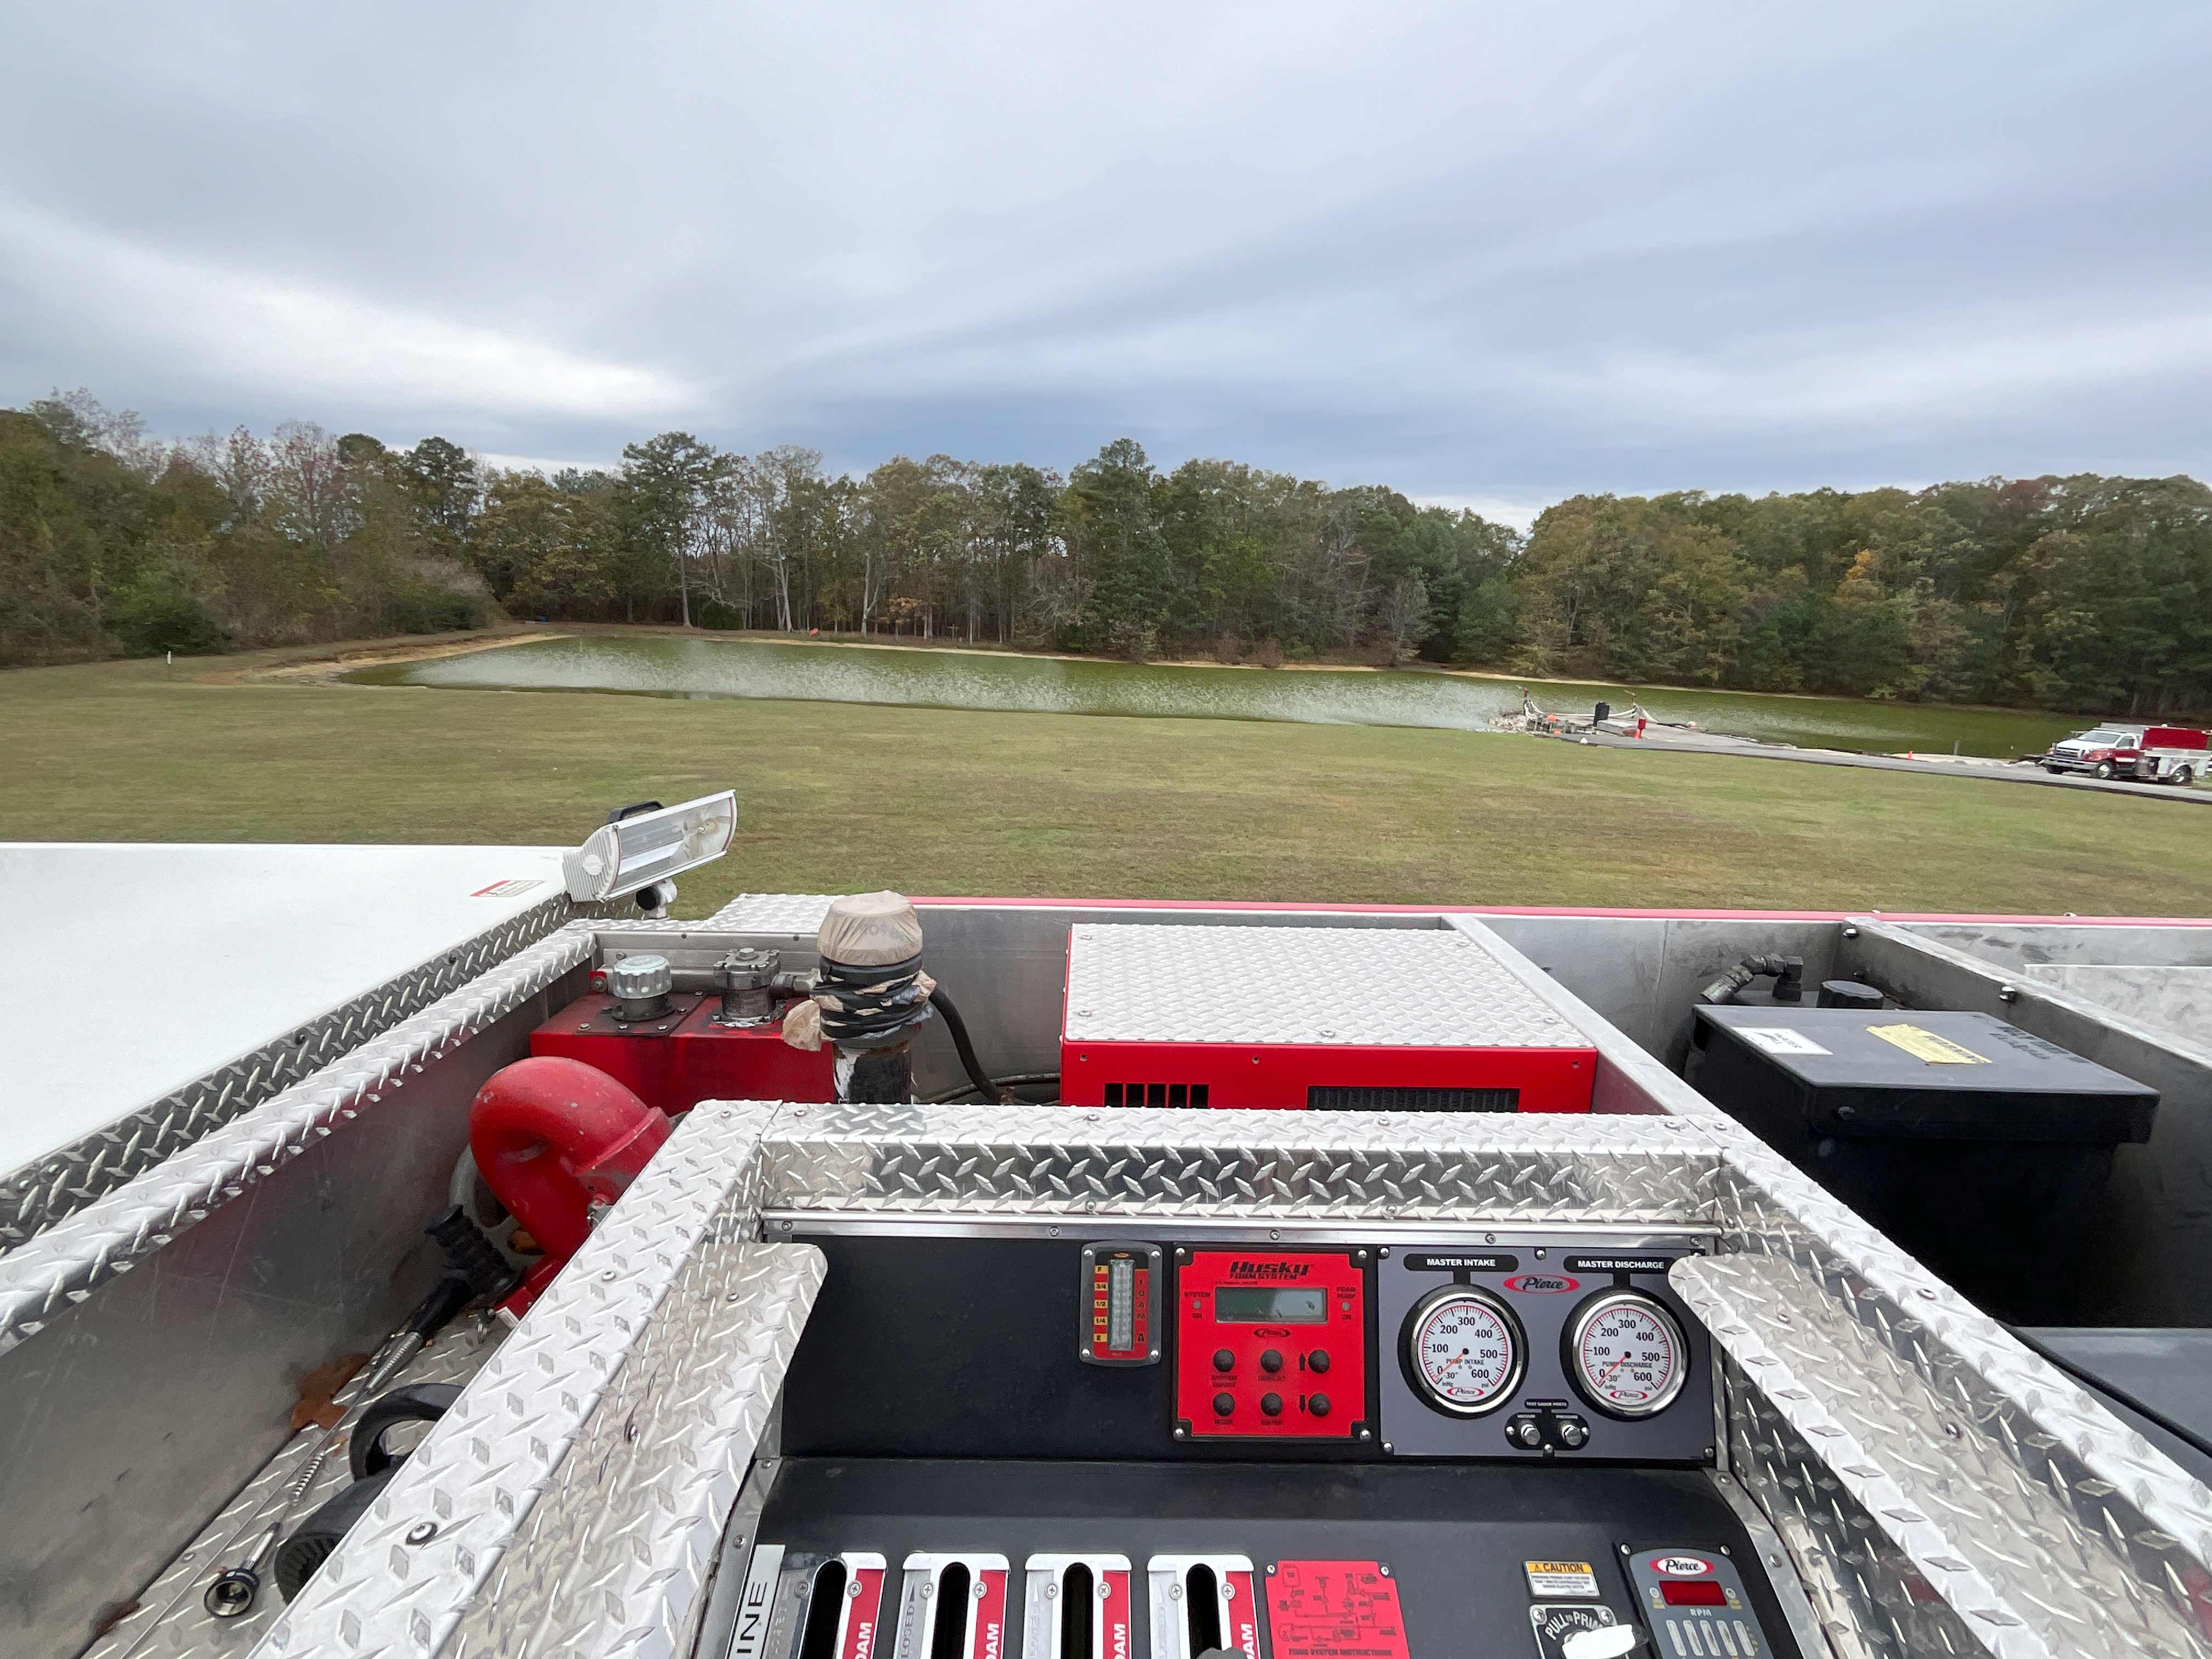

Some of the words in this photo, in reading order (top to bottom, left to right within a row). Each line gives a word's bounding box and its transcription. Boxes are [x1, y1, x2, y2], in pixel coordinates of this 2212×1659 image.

[1464, 1259, 1496, 1267] INTAKE
[1615, 1261, 1664, 1269] DISCHARGE
[1230, 1261, 1309, 1276] Husky
[1522, 1277, 1564, 1290] Pierce
[1458, 1317, 1475, 1326] 300
[1618, 1319, 1636, 1329] 300
[1440, 1325, 1458, 1334] 200
[1475, 1329, 1493, 1339] 400
[1601, 1328, 1619, 1337] 200
[1137, 1333, 1144, 1342] A
[1636, 1332, 1654, 1341] 400
[1432, 1344, 1448, 1353] 100
[1593, 1346, 1610, 1356] 100
[1480, 1349, 1498, 1359] 500
[1641, 1352, 1660, 1362] 500
[1437, 1365, 1443, 1375] 0
[1471, 1369, 1489, 1379] 600
[1599, 1369, 1605, 1378] 0
[1634, 1372, 1652, 1381] 600
[1543, 1562, 1584, 1573] CAUTION
[1665, 1559, 1700, 1574] Pierce
[1690, 1609, 1712, 1617] RPM
[1545, 1613, 1570, 1640] PULL
[1573, 1610, 1604, 1630] PRIM
